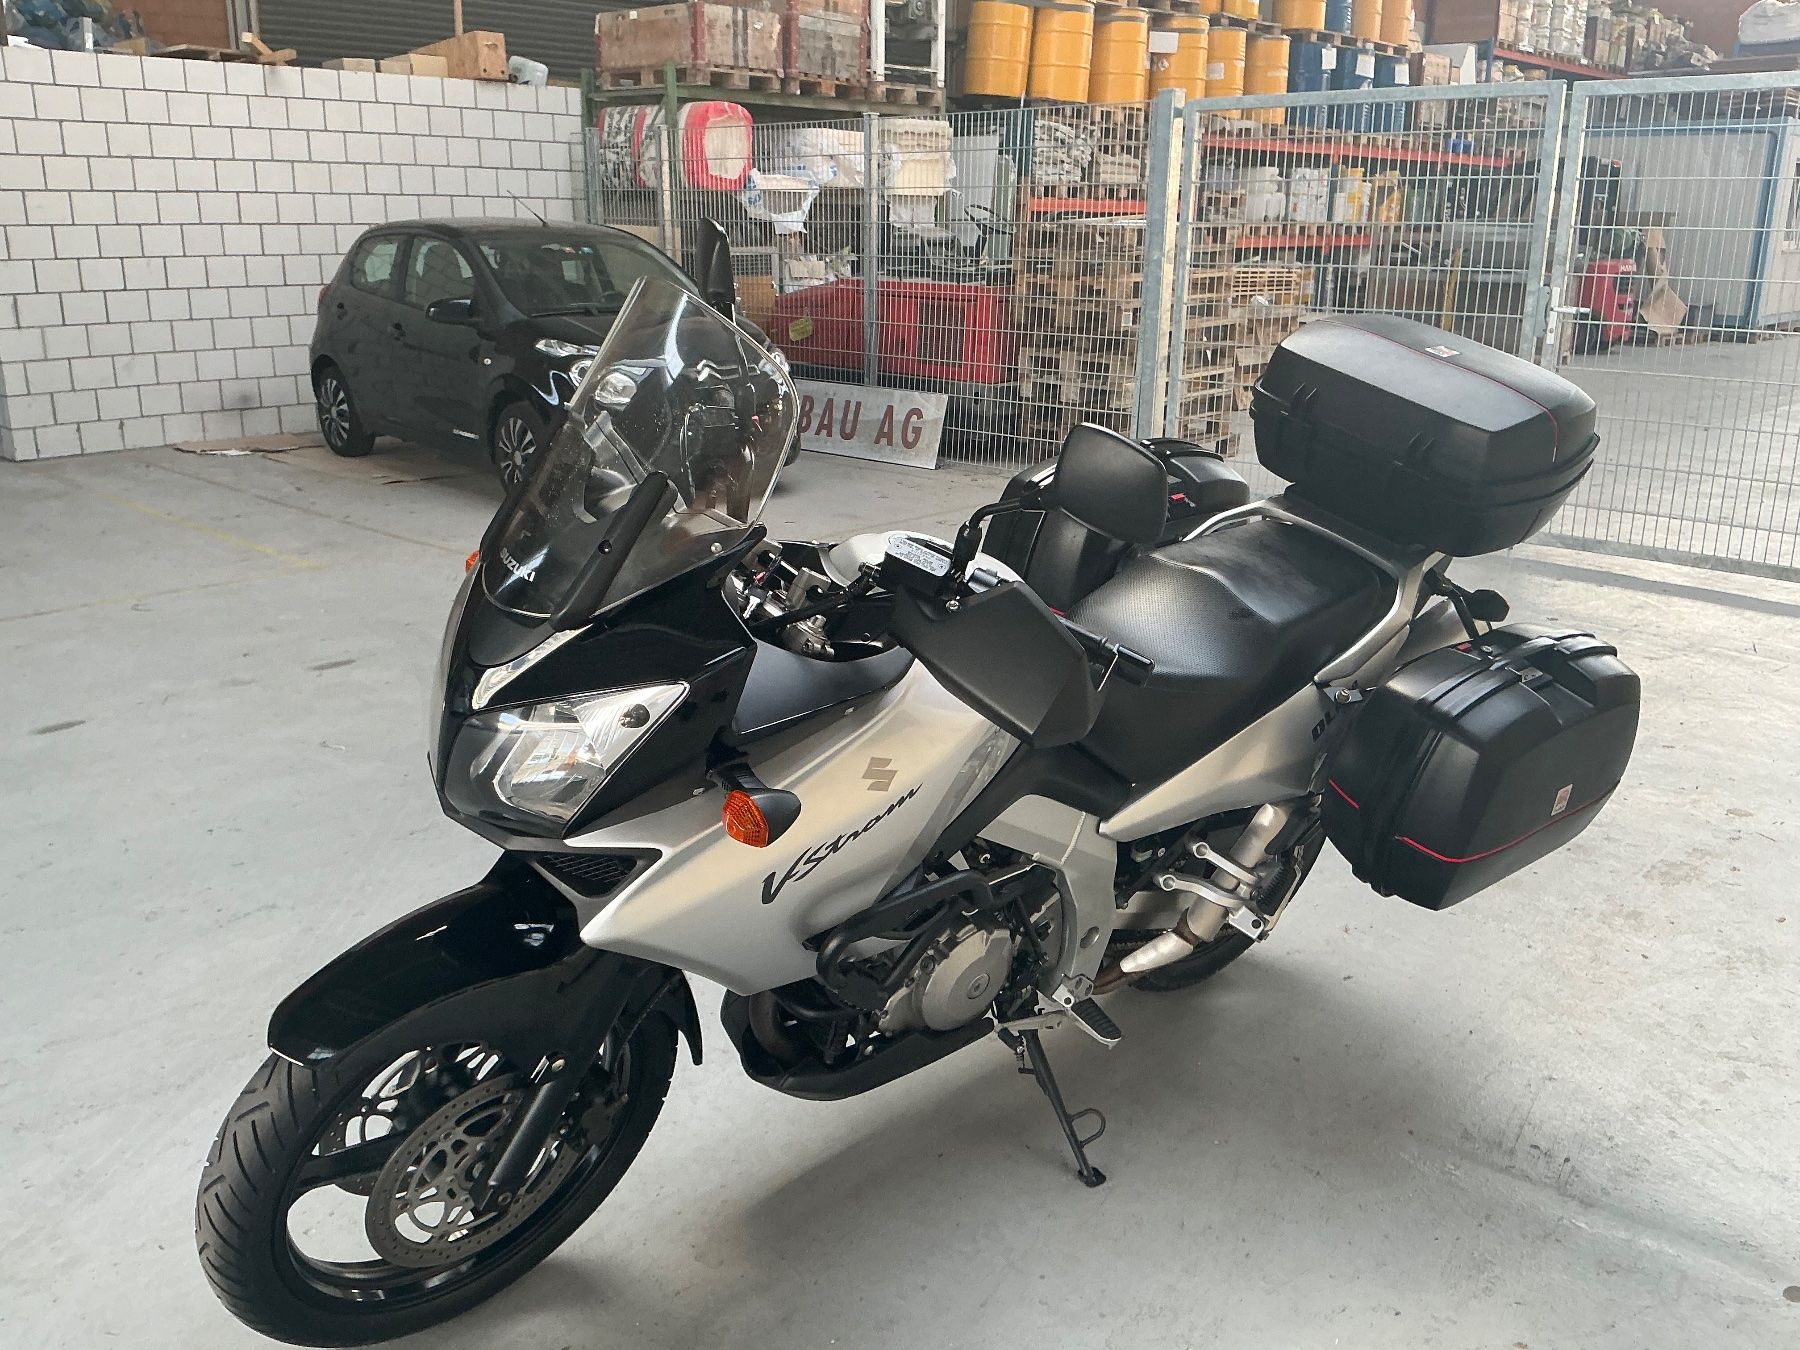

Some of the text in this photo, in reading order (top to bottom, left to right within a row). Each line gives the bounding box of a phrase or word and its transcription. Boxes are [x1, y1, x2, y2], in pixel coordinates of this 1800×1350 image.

[799, 395, 923, 449] BAU AG
[500, 547, 536, 582] SUZUKI
